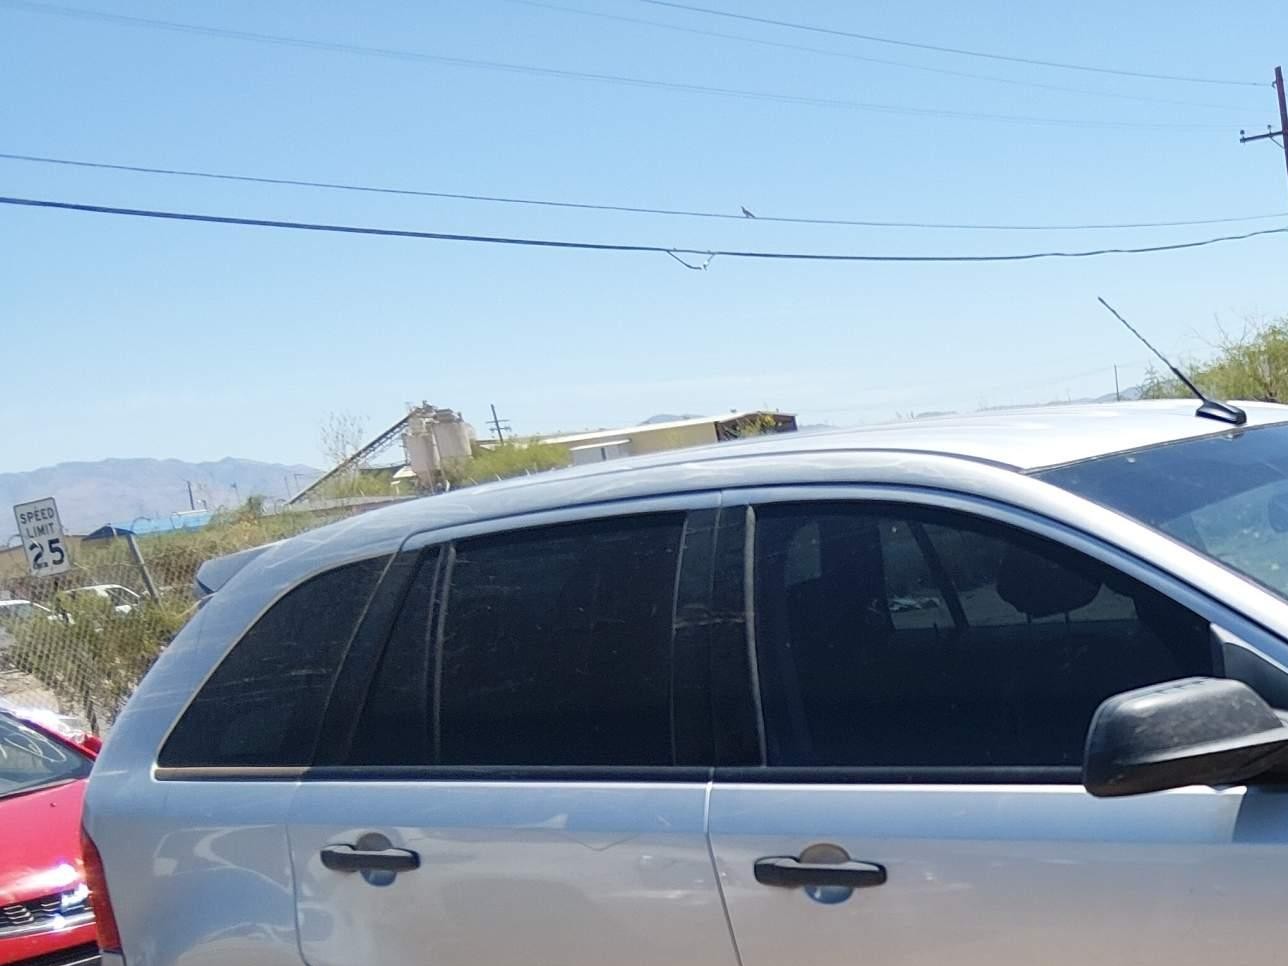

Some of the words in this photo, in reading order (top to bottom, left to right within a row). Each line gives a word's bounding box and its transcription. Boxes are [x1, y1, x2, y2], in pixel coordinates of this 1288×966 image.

[20, 508, 54, 524] SPEED
[26, 523, 54, 538] LIMIT
[29, 538, 64, 569] 25
